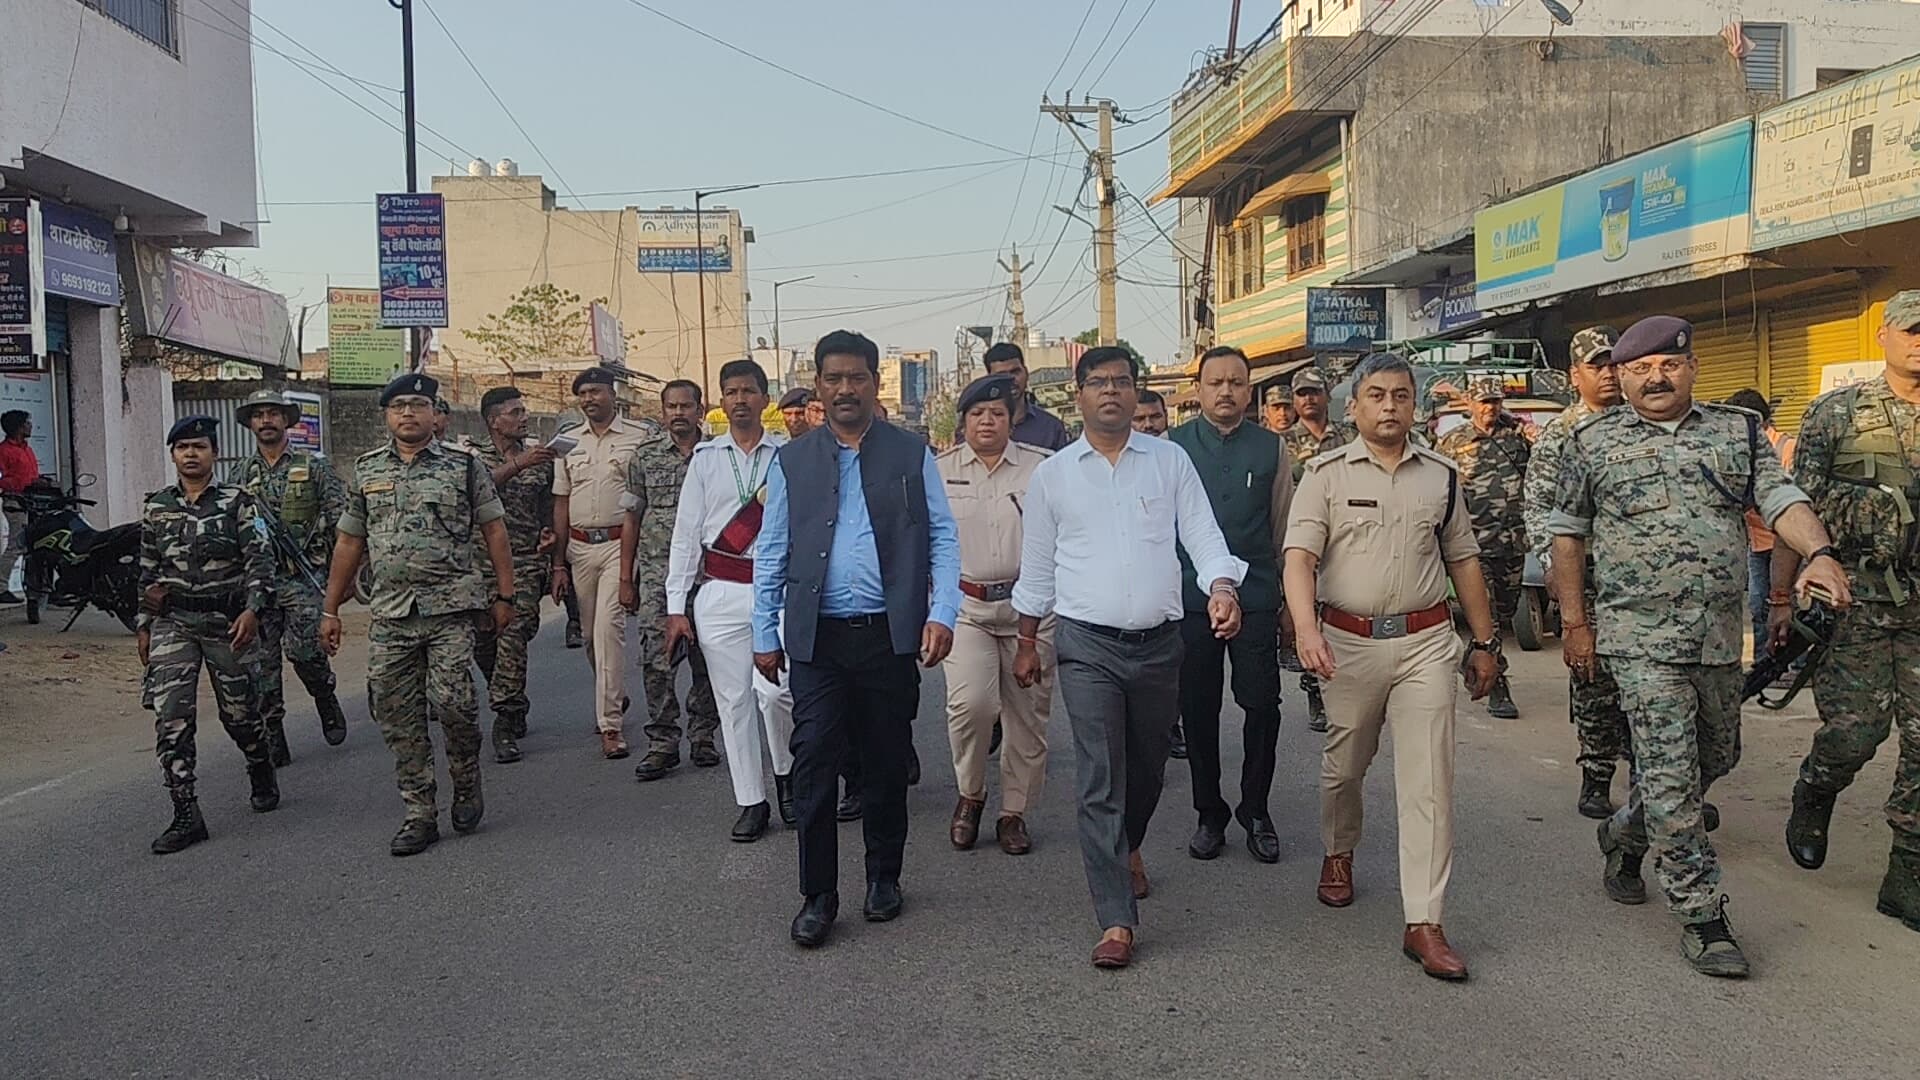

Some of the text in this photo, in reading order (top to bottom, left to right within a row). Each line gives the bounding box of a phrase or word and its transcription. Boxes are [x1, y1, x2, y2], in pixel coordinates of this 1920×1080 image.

[1642, 165, 1668, 185] MAK
[1506, 216, 1541, 247] MAK
[1505, 240, 1541, 260] LUBRICANTS
[1675, 241, 1718, 259] ENTERPRISES
[418, 264, 442, 280] 10%
[61, 272, 112, 297] 9693192123
[1323, 296, 1371, 308] TATKAL
[1314, 325, 1351, 345] ROAD
